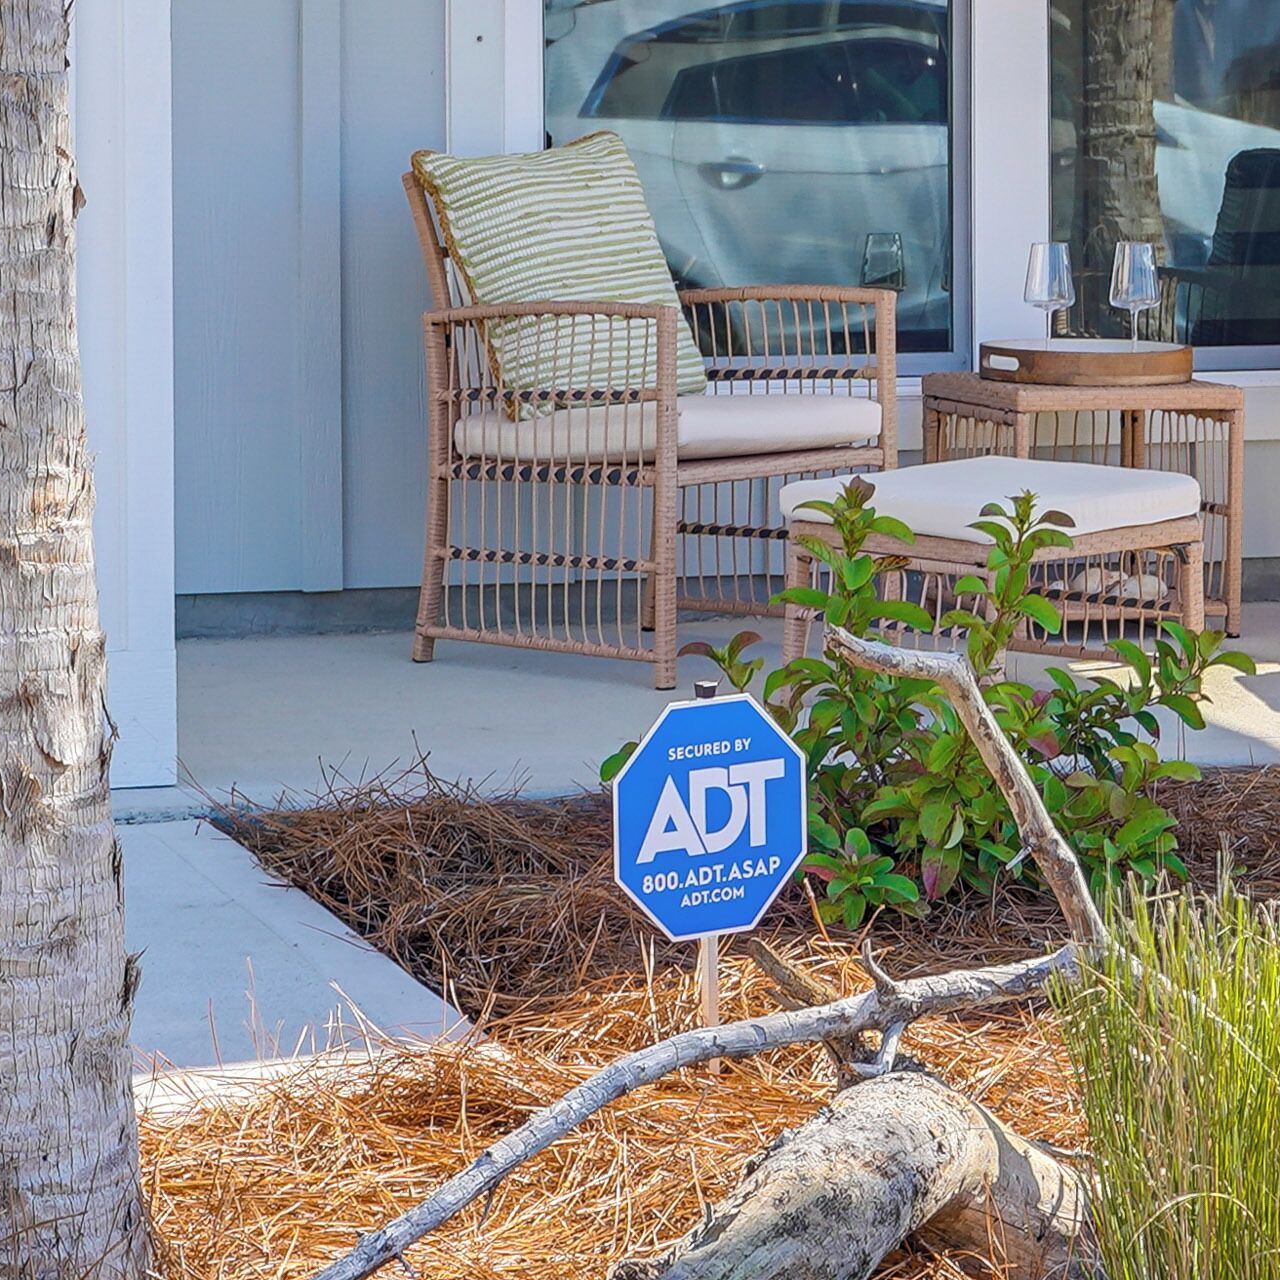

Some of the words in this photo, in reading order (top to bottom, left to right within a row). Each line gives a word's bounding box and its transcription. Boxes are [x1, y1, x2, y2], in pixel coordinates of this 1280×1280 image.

[668, 741, 731, 761] SECURED
[734, 738, 752, 752] BY
[635, 758, 785, 865] ADT
[642, 856, 781, 894] 800.ADT.ASAP
[680, 885, 745, 908] ADT.COM
